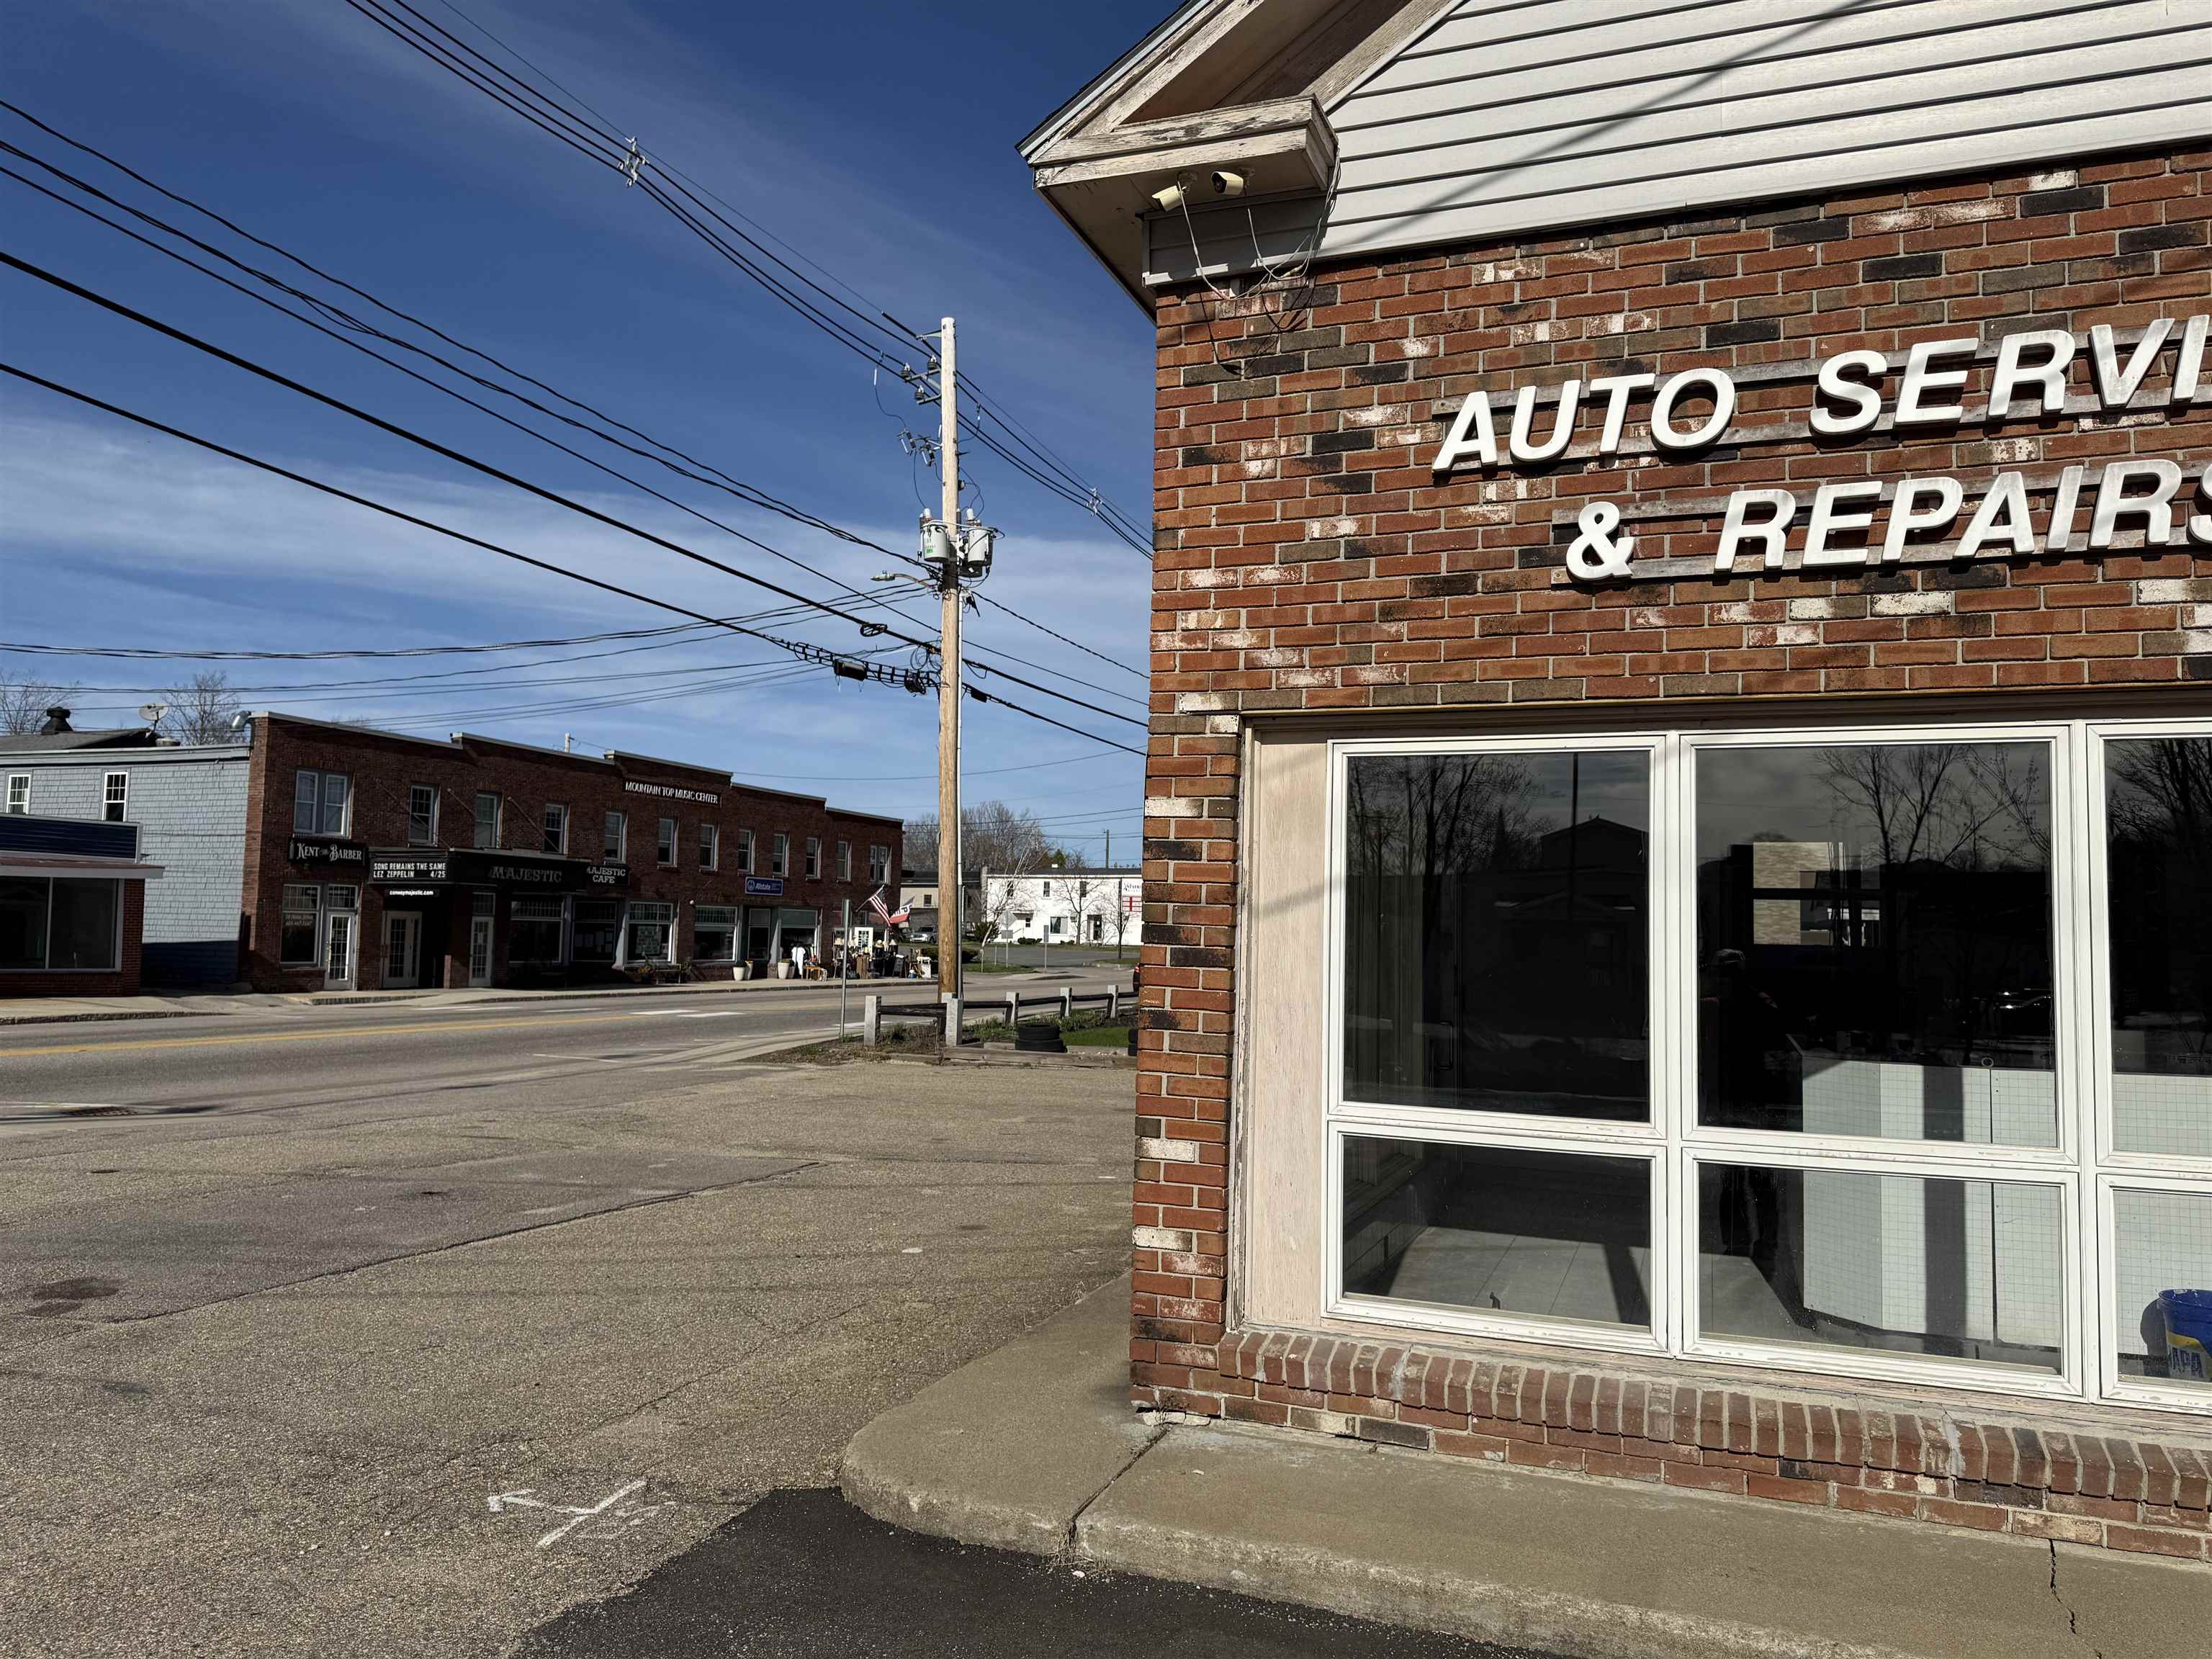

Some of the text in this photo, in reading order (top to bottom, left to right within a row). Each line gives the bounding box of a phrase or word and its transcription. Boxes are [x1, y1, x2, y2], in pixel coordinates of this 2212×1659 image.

[1432, 315, 2210, 472] AUTO SERVI
[1566, 502, 1637, 580] &
[625, 781, 719, 804] MOUNTAIN TOP MUSIC CENTER
[488, 866, 562, 883] MAJESTIC
[593, 875, 616, 884] CAFE
